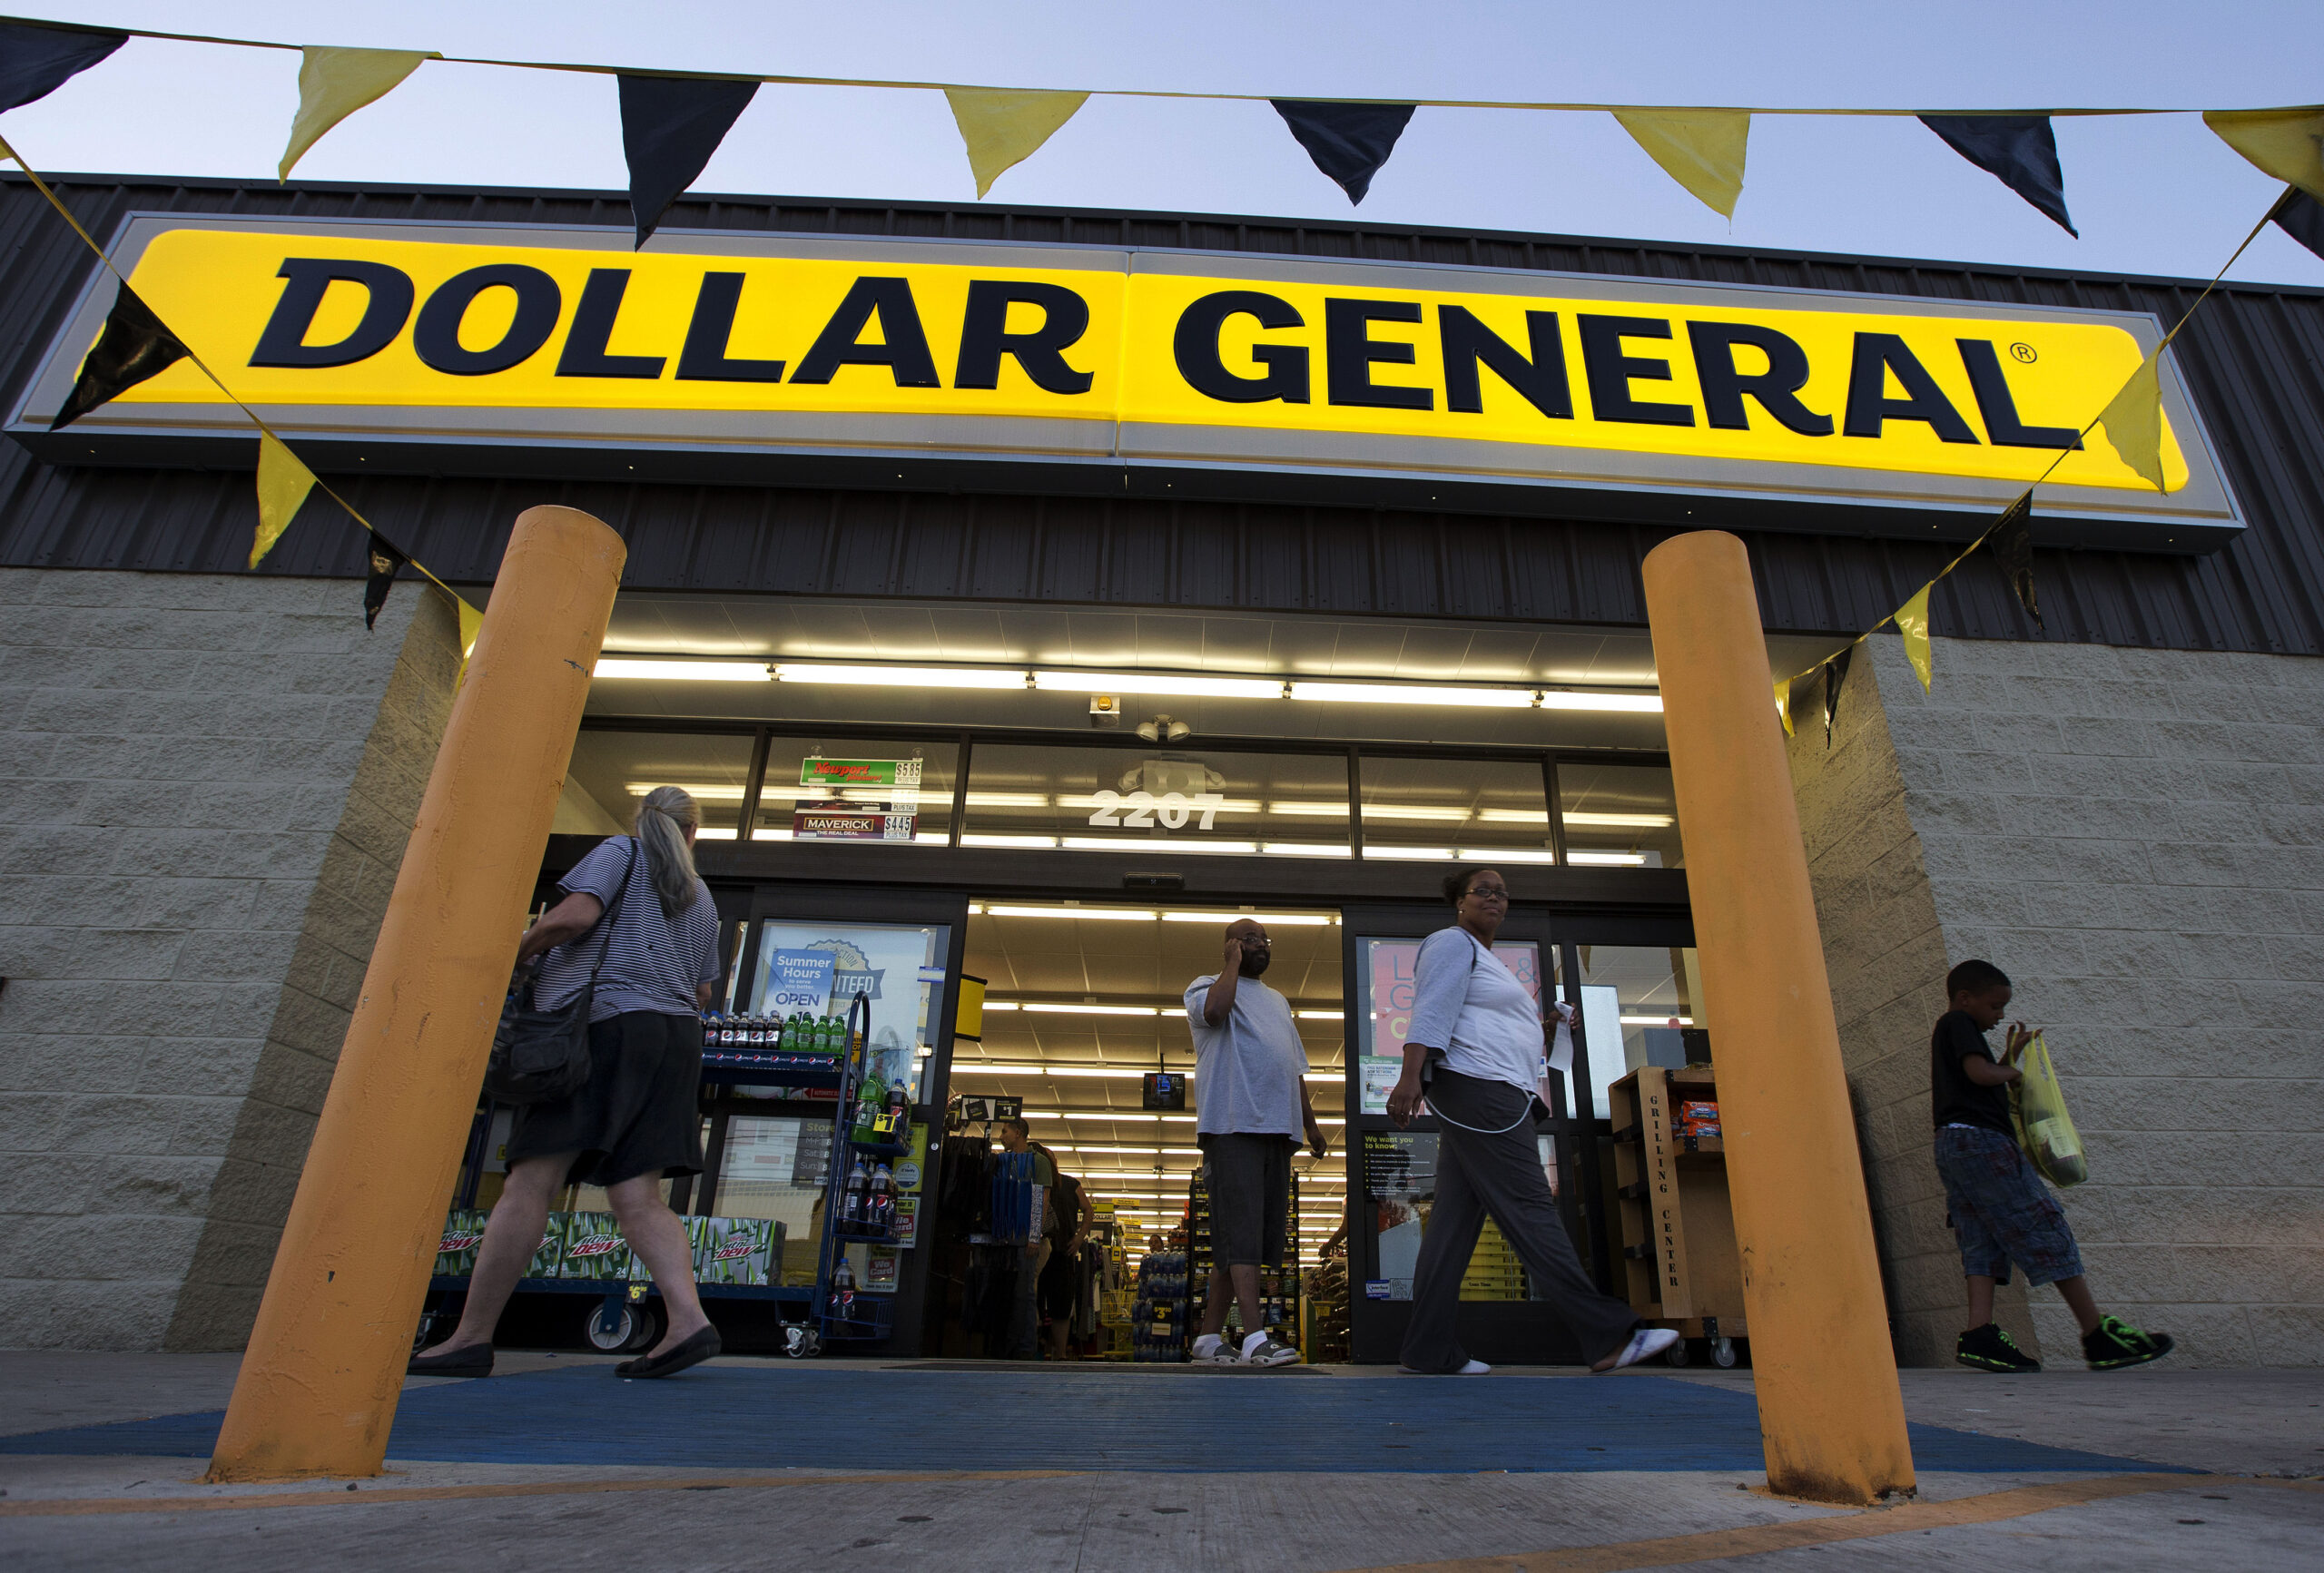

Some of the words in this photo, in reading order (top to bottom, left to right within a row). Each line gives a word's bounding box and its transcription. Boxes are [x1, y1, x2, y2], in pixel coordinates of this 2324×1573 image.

[248, 257, 1094, 393] DOLLAR
[1172, 289, 2084, 450] GENERAL
[813, 762, 871, 777] Newport
[1089, 790, 1224, 831] 2207
[808, 819, 870, 830] MAVERICK
[777, 956, 831, 968] Summer
[783, 968, 821, 978] Hours
[775, 993, 821, 1007] OPEN
[806, 1123, 835, 1133] Store
[878, 1116, 893, 1131] $1
[1649, 1096, 1668, 1194] GRILLING
[1662, 1209, 1679, 1287] CENTER
[756, 1273, 765, 1281] 24
